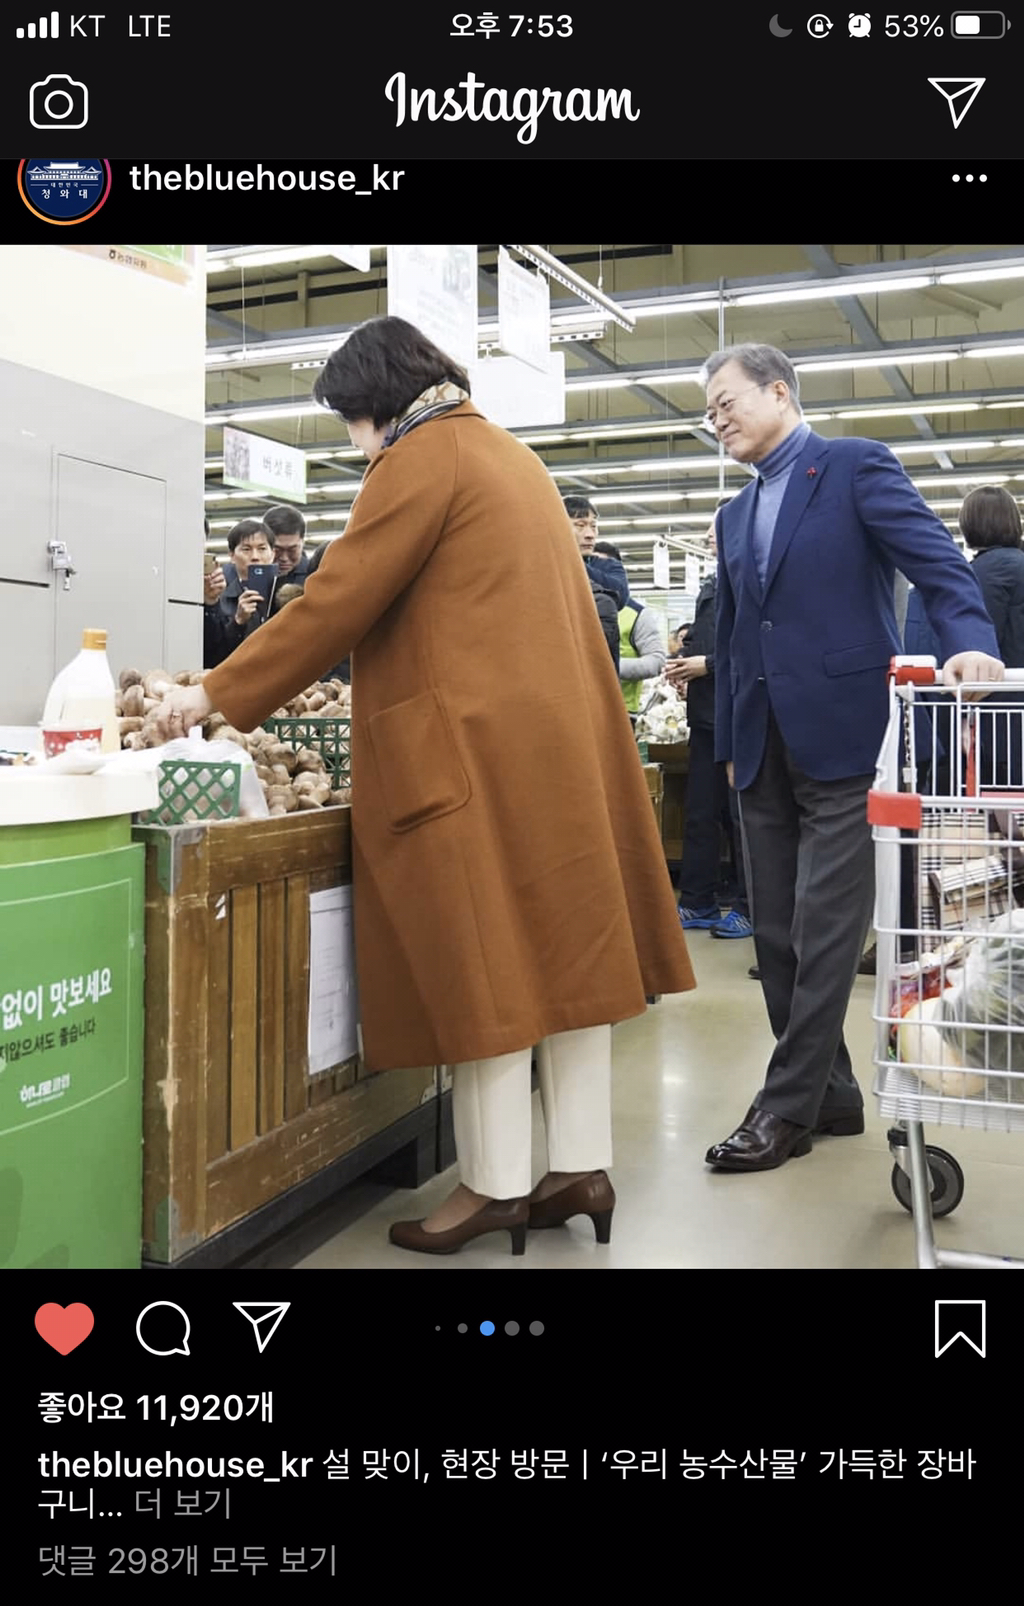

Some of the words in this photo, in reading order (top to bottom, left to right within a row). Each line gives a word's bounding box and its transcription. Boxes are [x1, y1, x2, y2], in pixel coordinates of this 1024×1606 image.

[0, 985, 43, 1030] 없이
[50, 967, 112, 1018] 맛보세요
[59, 1018, 96, 1047] 좋습니다
